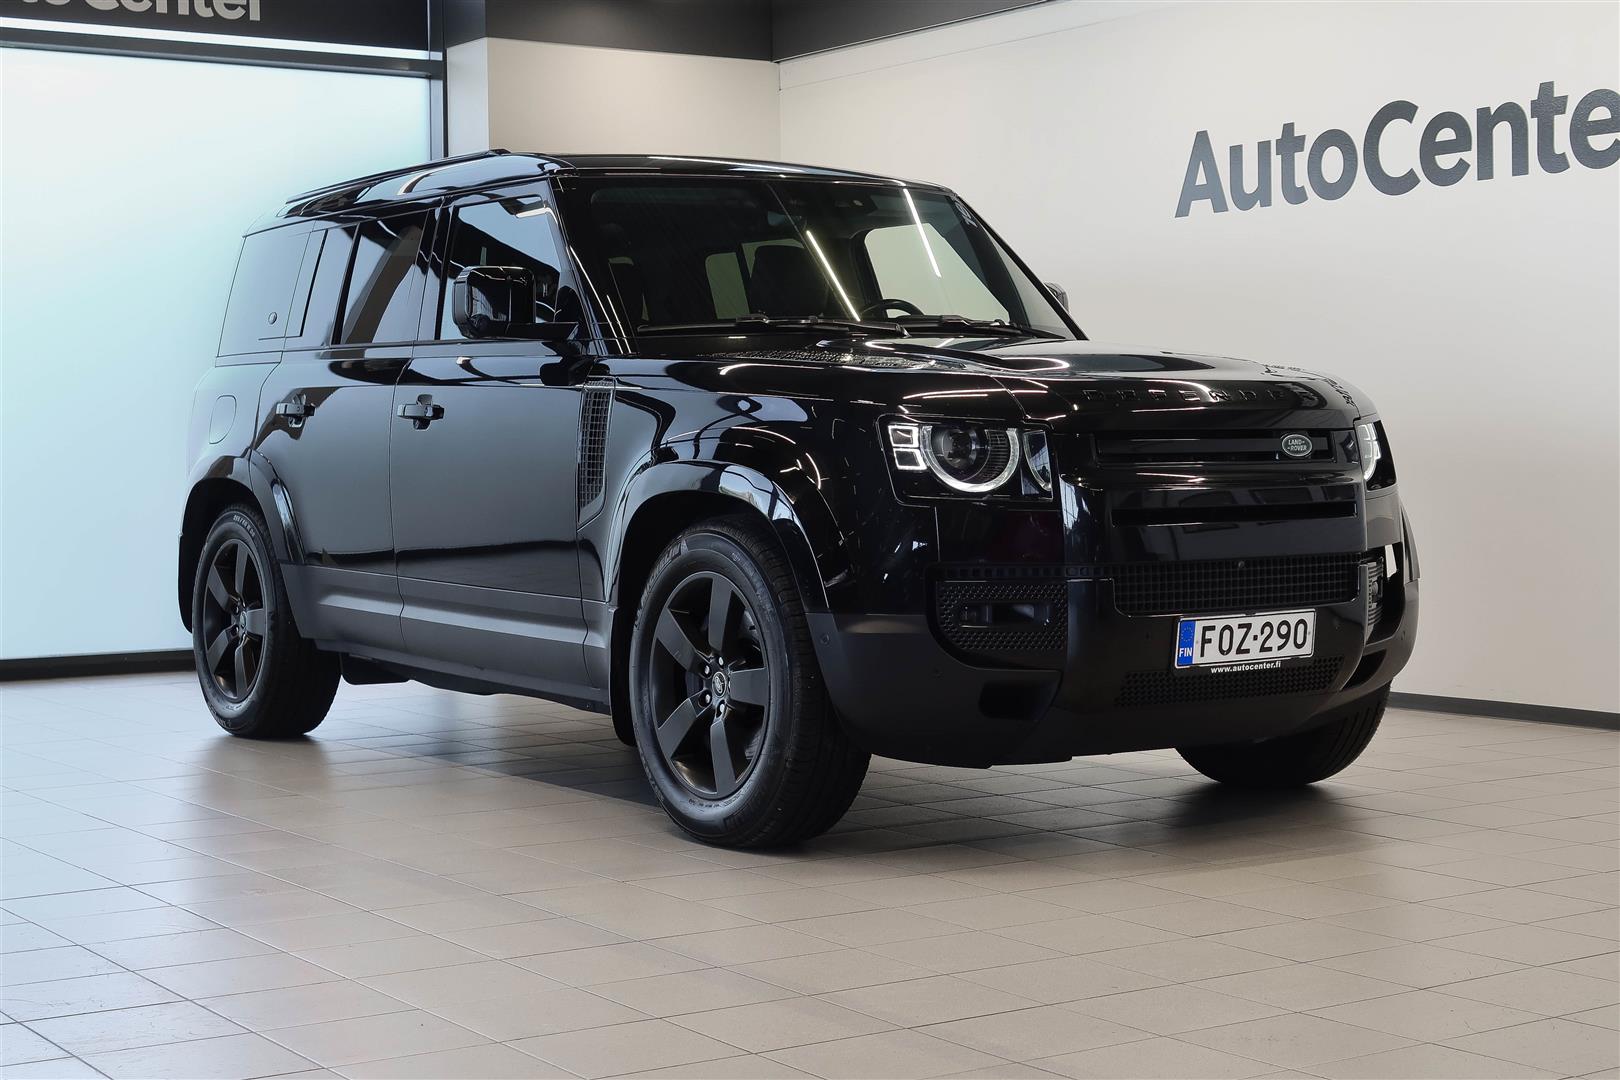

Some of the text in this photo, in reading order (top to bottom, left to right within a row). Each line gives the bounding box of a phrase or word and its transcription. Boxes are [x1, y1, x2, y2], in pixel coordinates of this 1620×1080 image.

[1082, 388, 1317, 402] DEFENDE
[1178, 647, 1193, 658] FIN
[1211, 660, 1281, 674] www.autocenter.fi
